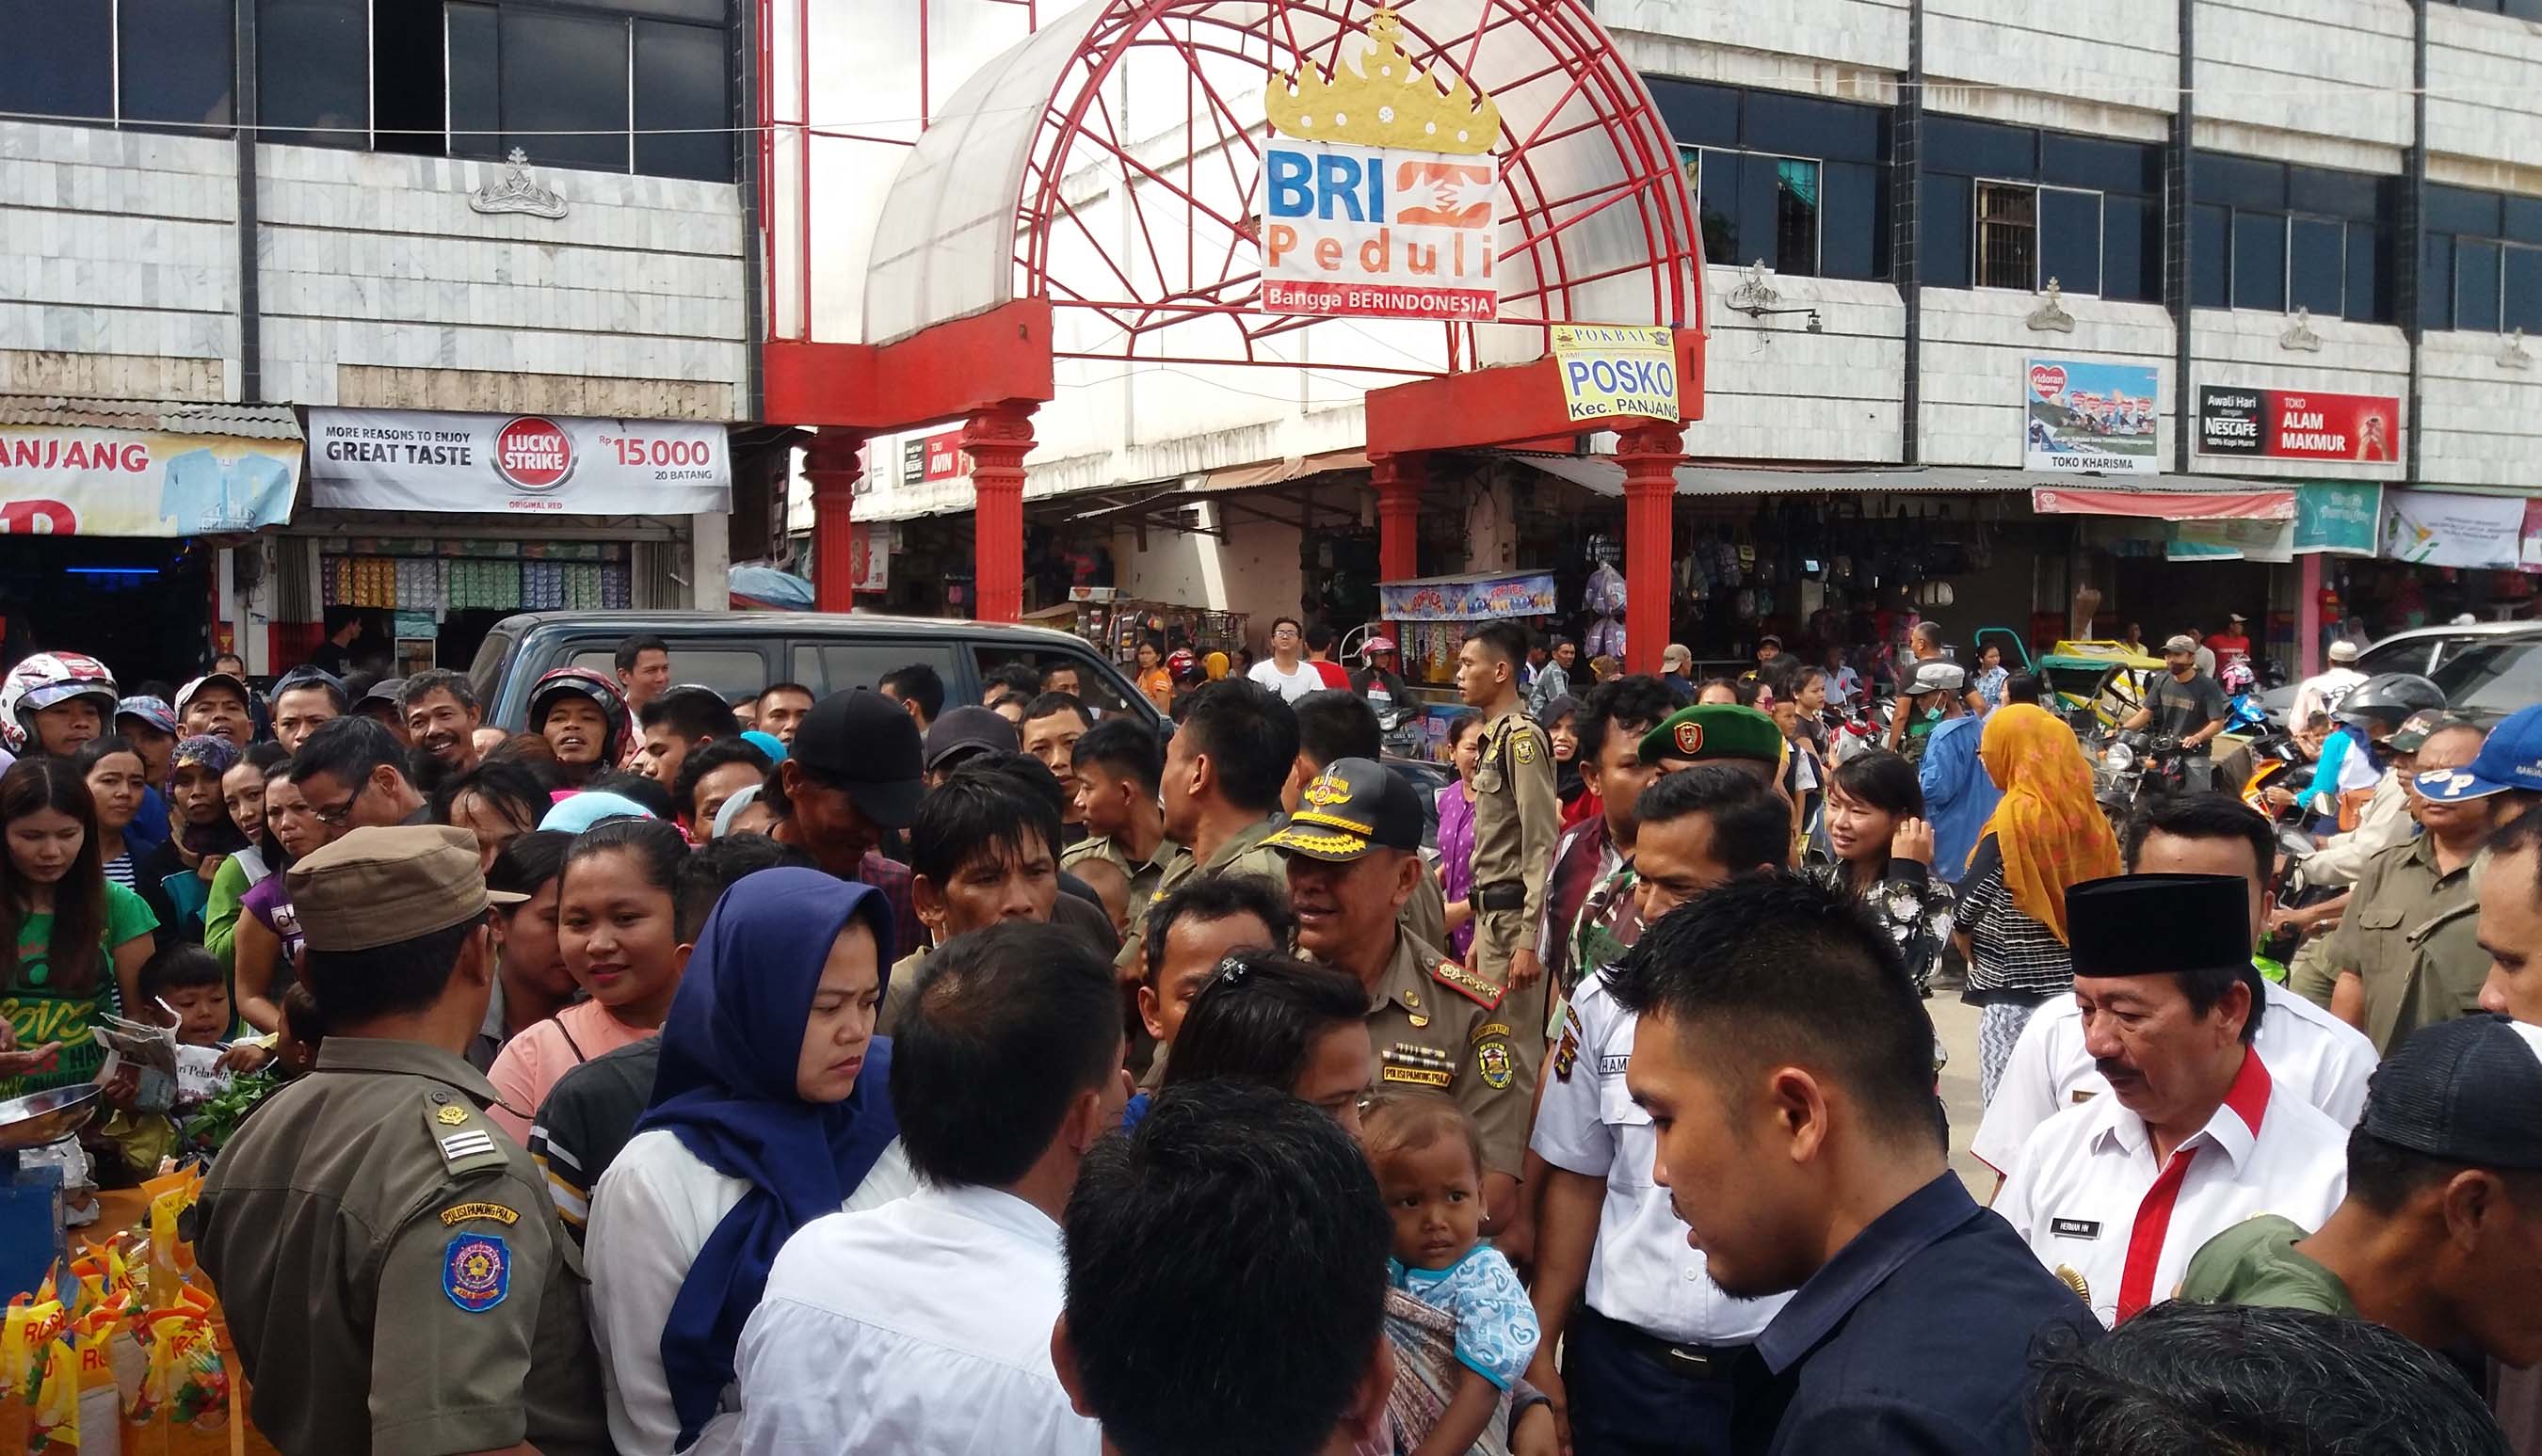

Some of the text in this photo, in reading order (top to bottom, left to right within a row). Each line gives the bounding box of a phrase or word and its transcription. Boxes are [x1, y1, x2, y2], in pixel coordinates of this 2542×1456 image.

[1267, 150, 1385, 223] BRI
[1268, 224, 1492, 279] Peduli
[1269, 288, 1490, 314] Bangga BERINDONESIA
[1568, 360, 1674, 397] POSKO
[1570, 398, 1678, 419] Kec. PANJANG
[2208, 395, 2257, 408] Awali Hari
[2284, 397, 2306, 408] TOKO
[2283, 412, 2324, 430] ALAM
[326, 426, 471, 443] MORE REASONS TO ENJOY
[2281, 433, 2346, 452] MAKMUR
[326, 441, 472, 466] GREAT TASTE
[505, 434, 564, 471] LUCKY STRIKE
[599, 435, 710, 466] Rp 15.000
[2051, 456, 2133, 470] TOKO KHARISMA
[654, 470, 713, 480] 20 BATANG
[509, 501, 563, 510] ORIGINAL RED
[1386, 1068, 1406, 1079] POLISI
[1407, 1070, 1432, 1081] PAMONG
[443, 1207, 468, 1223] POLISI
[467, 1204, 495, 1217] PAMONG
